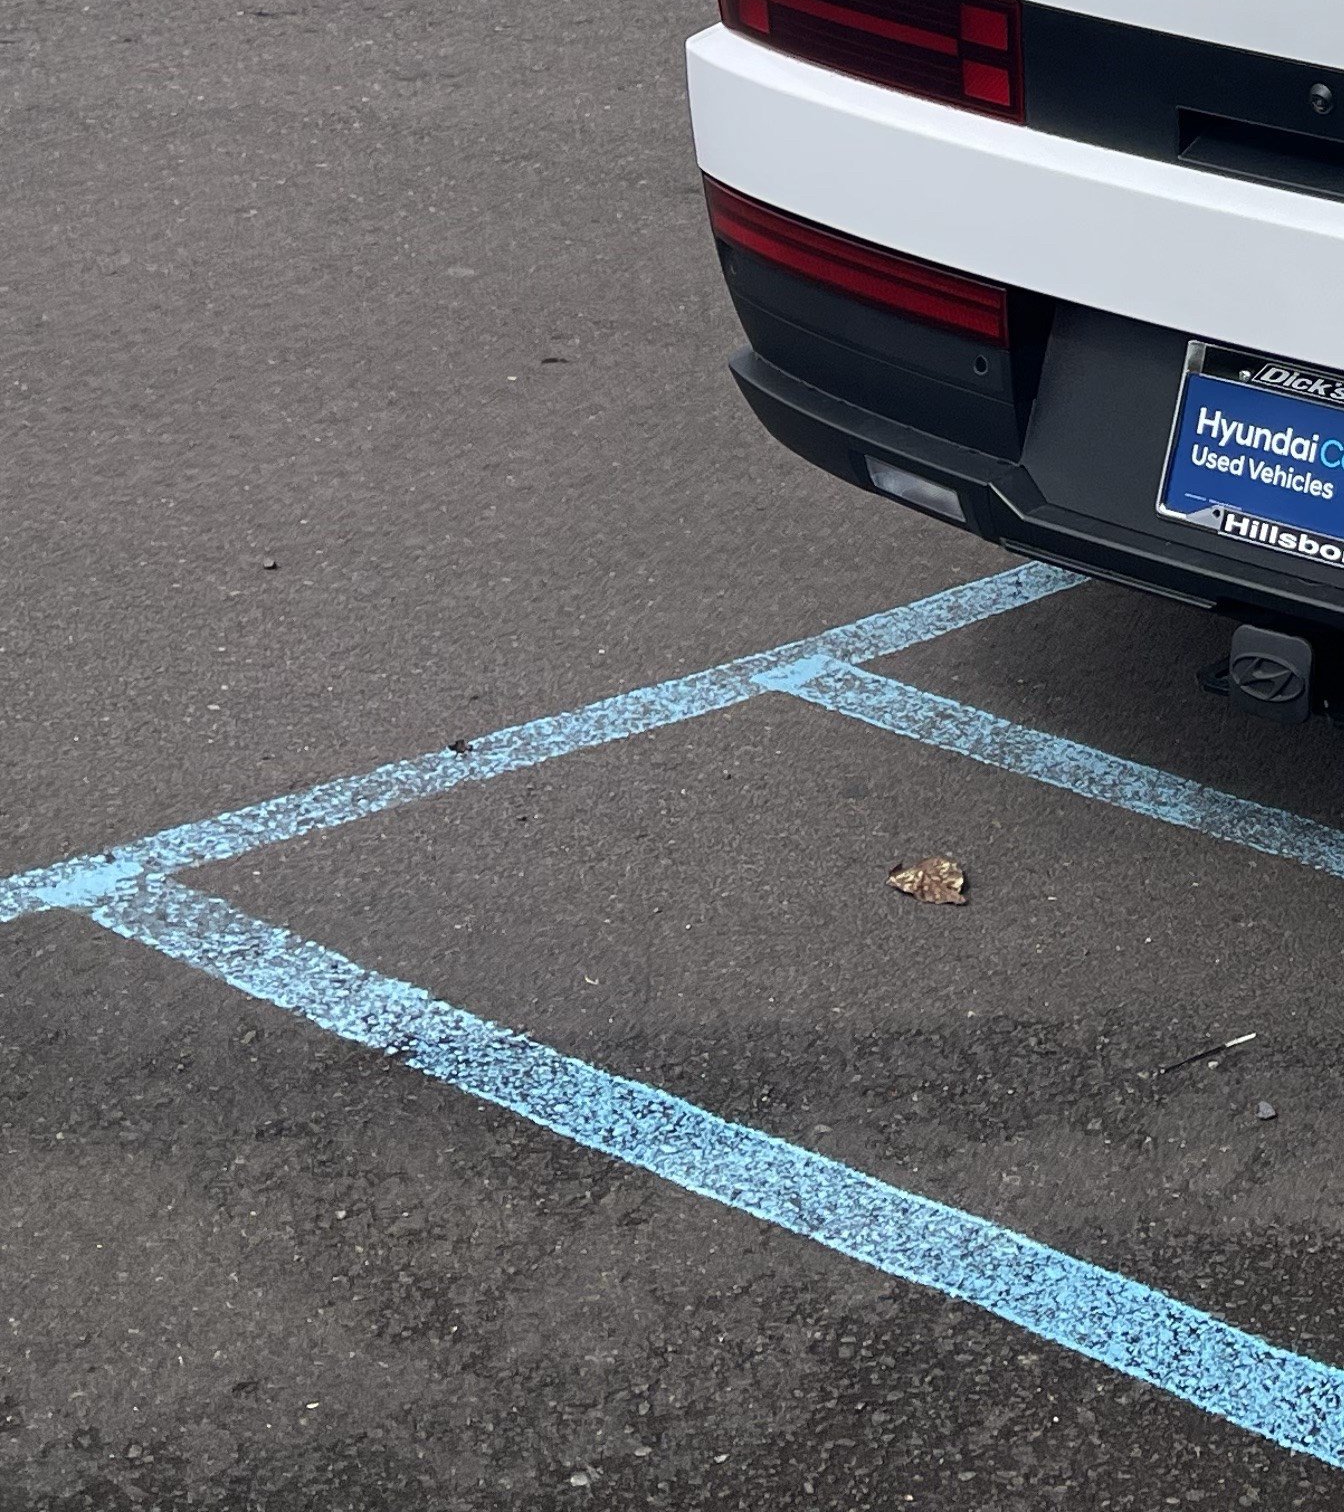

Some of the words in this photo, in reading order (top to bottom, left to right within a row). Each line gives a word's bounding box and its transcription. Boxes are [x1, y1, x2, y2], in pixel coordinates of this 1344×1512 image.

[1195, 407, 1320, 463] Hyundai
[1191, 443, 1245, 476] Used
[1248, 457, 1335, 500] Vehicles
